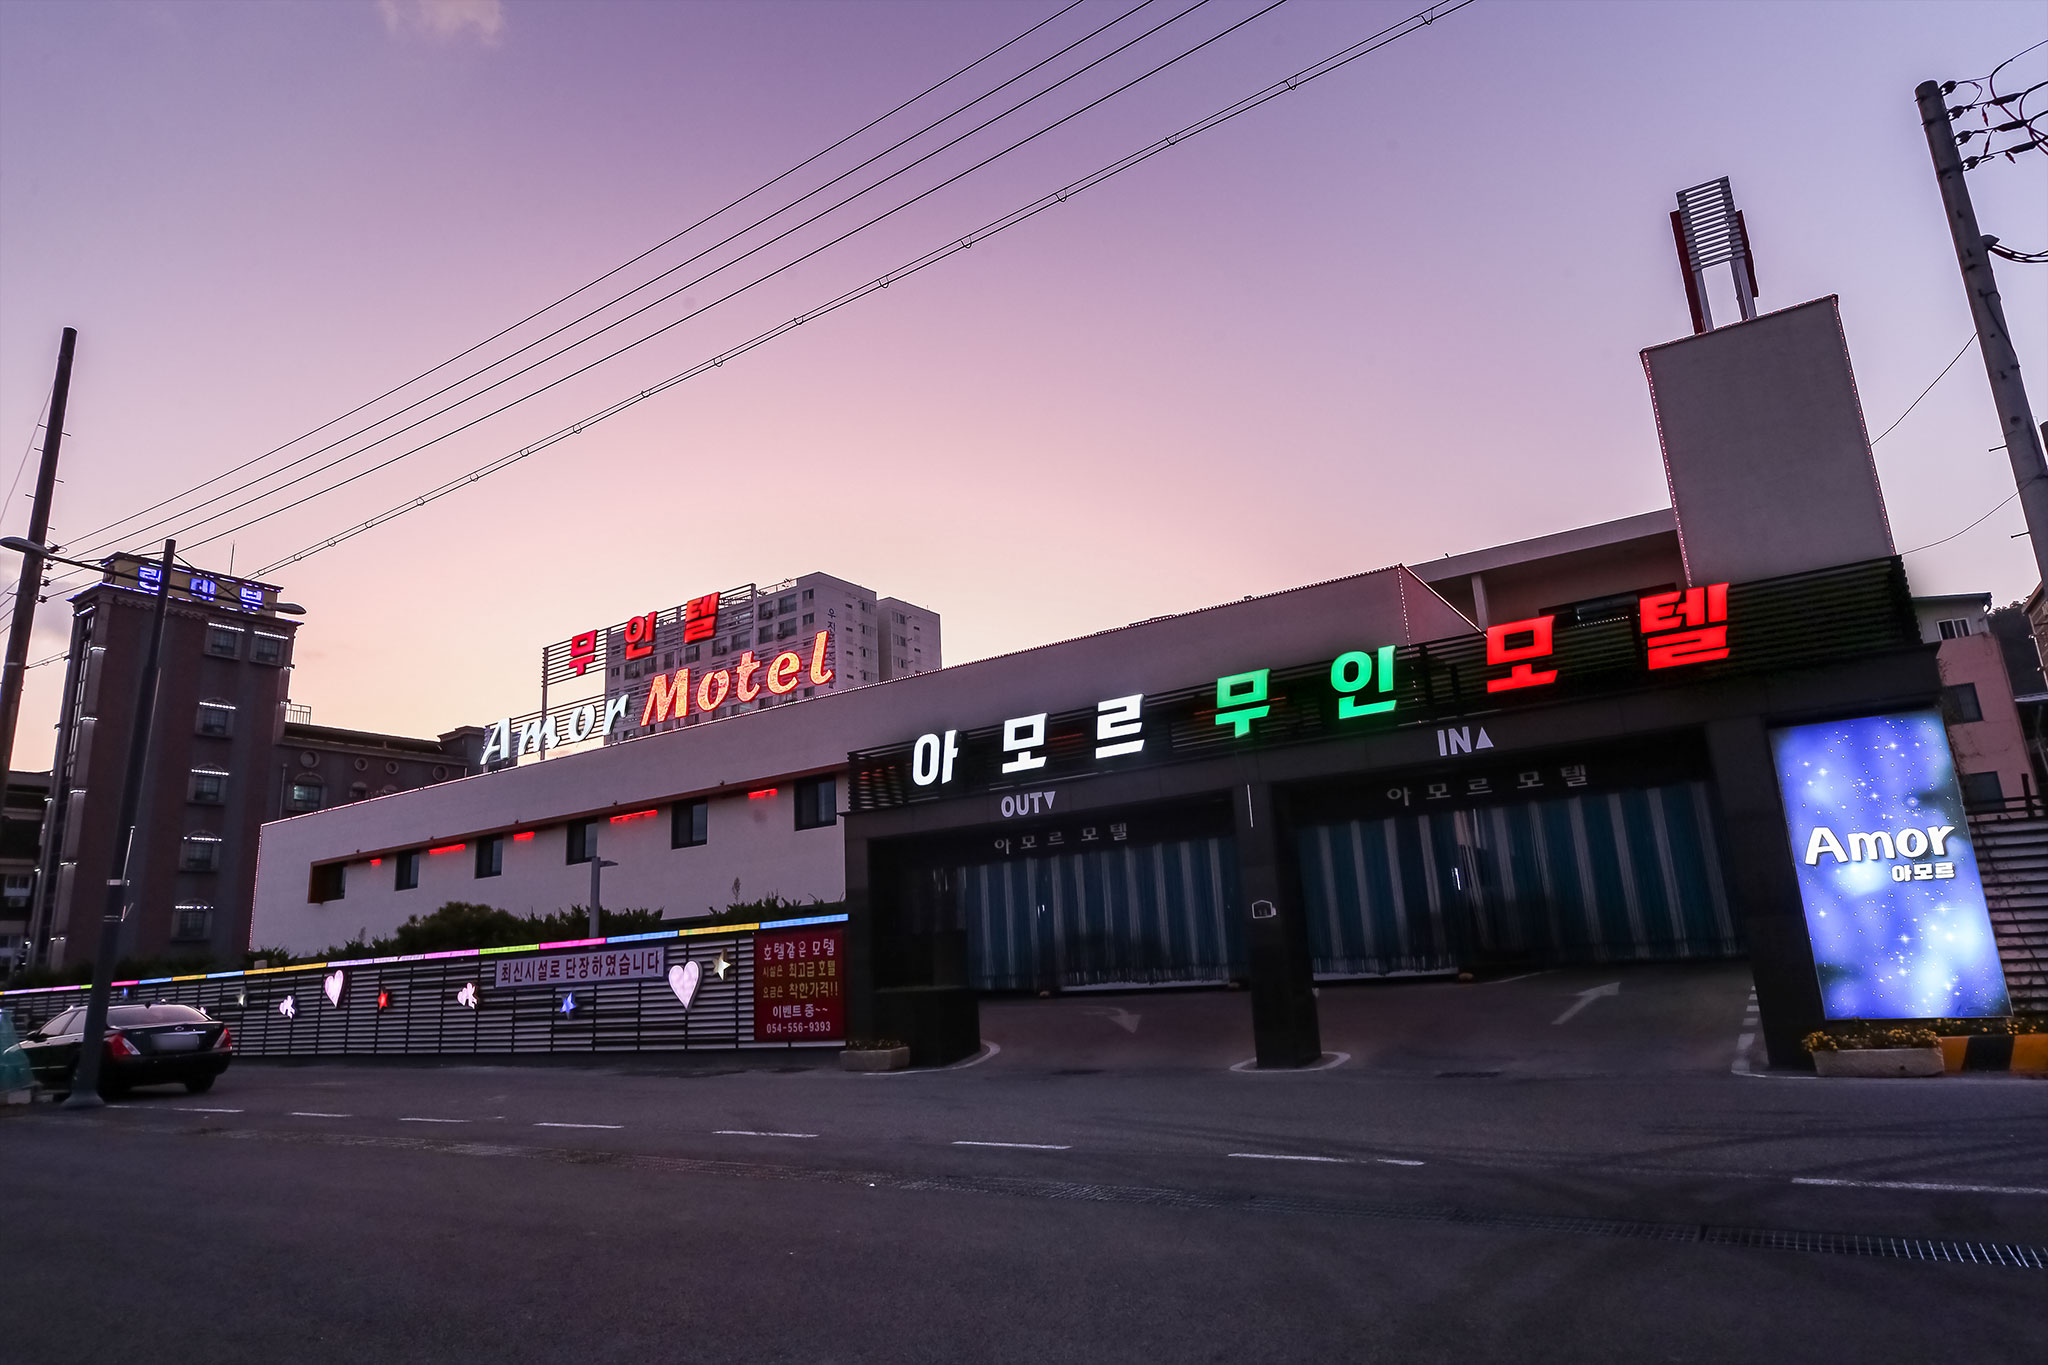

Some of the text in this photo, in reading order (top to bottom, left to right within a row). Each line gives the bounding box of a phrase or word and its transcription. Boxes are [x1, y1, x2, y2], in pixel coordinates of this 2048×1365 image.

[568, 591, 720, 676] 무인텔
[480, 693, 629, 765] Amor
[640, 630, 834, 727] Motel
[912, 582, 1730, 787] 아모르 무인 모텔
[1437, 726, 1472, 757] IN
[1387, 764, 1588, 806] 아모르 모텔
[1001, 792, 1042, 818] OUT
[994, 822, 1127, 855] 아모르 모텔
[1804, 825, 1956, 866] Amor
[1891, 862, 1956, 882] 아모르
[812, 938, 835, 956] 모텔
[501, 950, 660, 983] 최신시설로 단장하였습니다
[763, 960, 836, 978] 시설은 최고급 호텔
[763, 981, 838, 999] 요금은 착한가격!!
[772, 1004, 802, 1018] 이벤트
[766, 1021, 831, 1034] 054-556-9393
